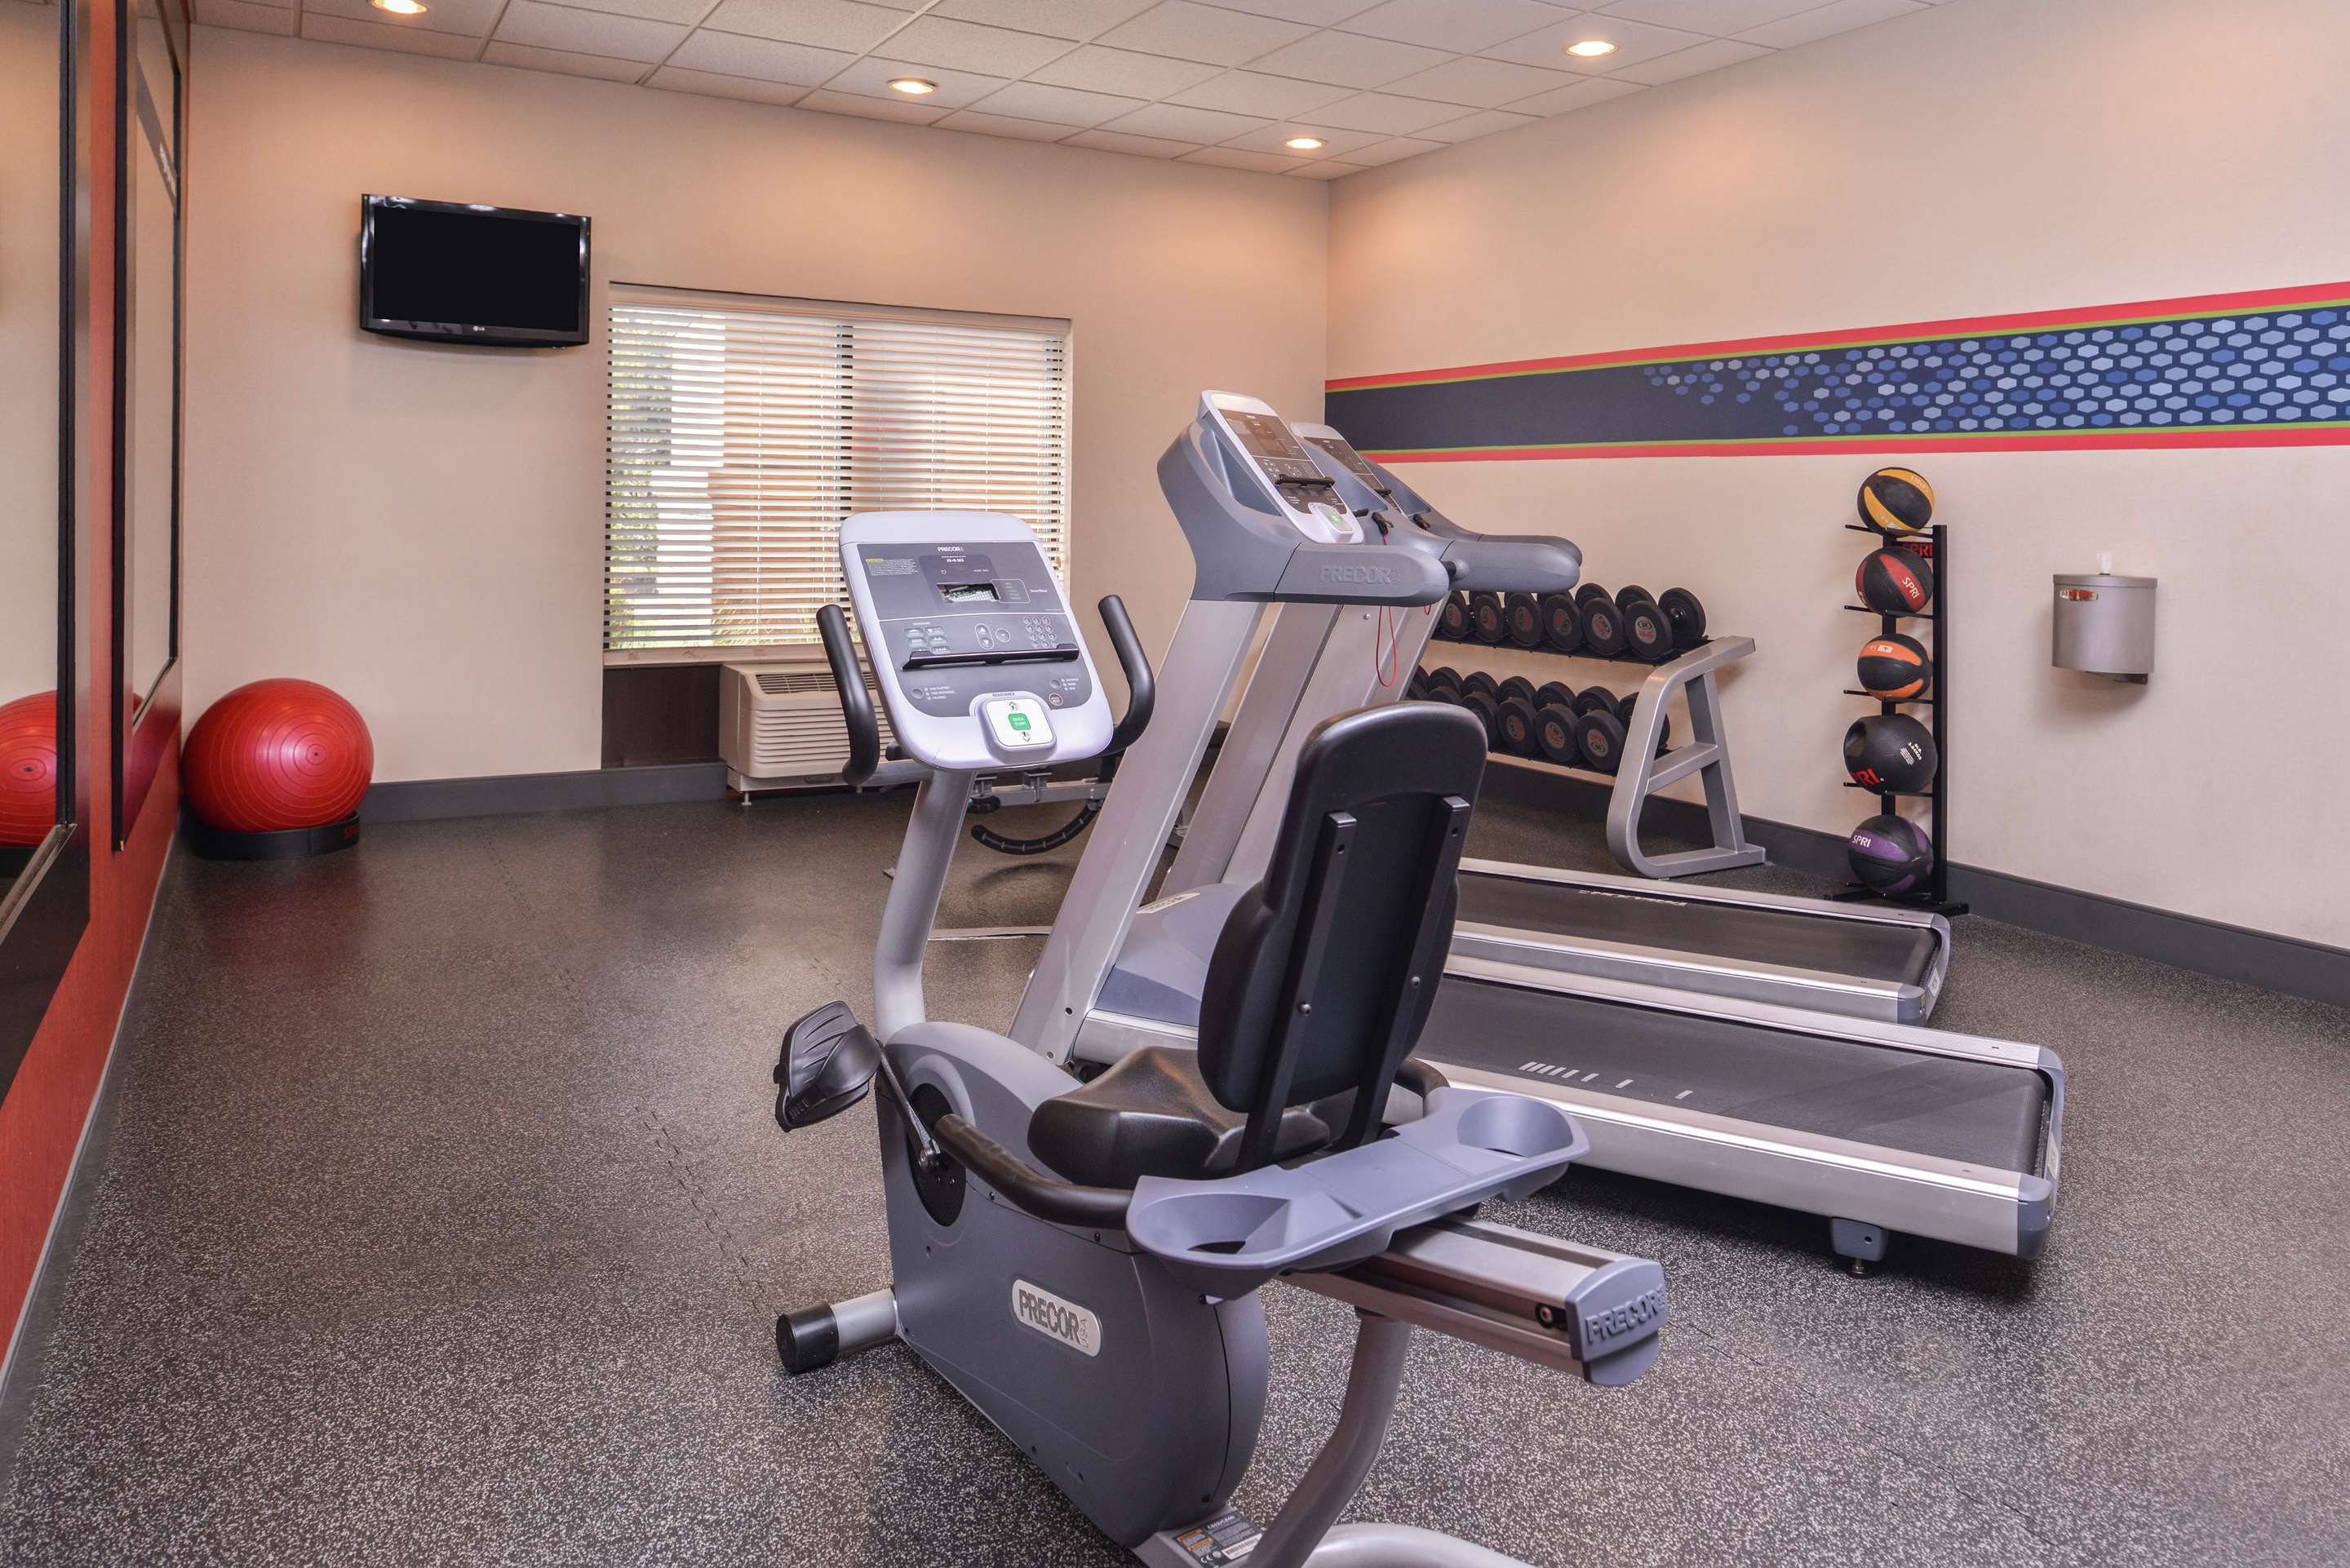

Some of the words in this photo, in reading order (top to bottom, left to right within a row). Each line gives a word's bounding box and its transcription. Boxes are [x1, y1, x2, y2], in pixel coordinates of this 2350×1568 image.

[1902, 577, 1920, 599] SPRI
[1851, 835, 1871, 848] SPRI
[1018, 1288, 1081, 1344] PRECOR
[1585, 1289, 1659, 1344] PRECOR
